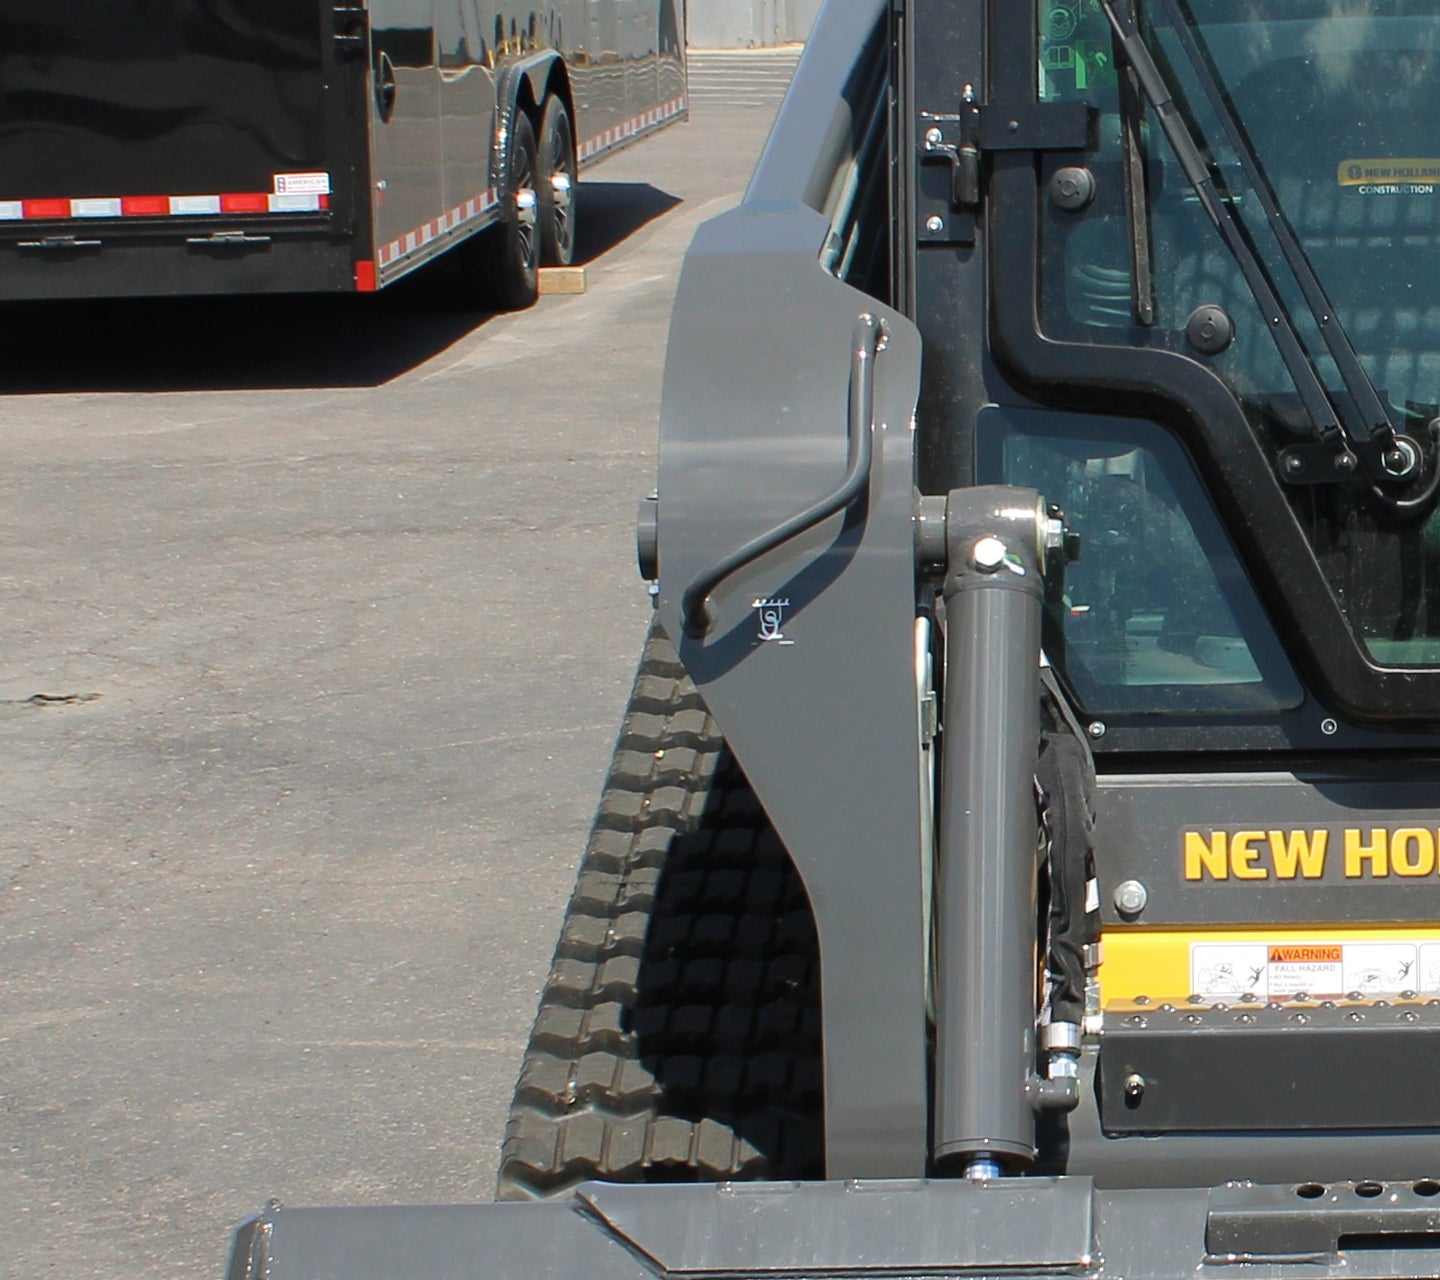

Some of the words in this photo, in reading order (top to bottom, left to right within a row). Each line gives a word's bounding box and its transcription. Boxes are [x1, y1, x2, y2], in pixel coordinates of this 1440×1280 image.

[1365, 167, 1391, 177] NEW
[1358, 184, 1433, 195] CONSTRUCTION
[1183, 829, 1329, 881] NEW
[1281, 948, 1340, 961] WARNING
[1298, 964, 1336, 972] HAZARD
